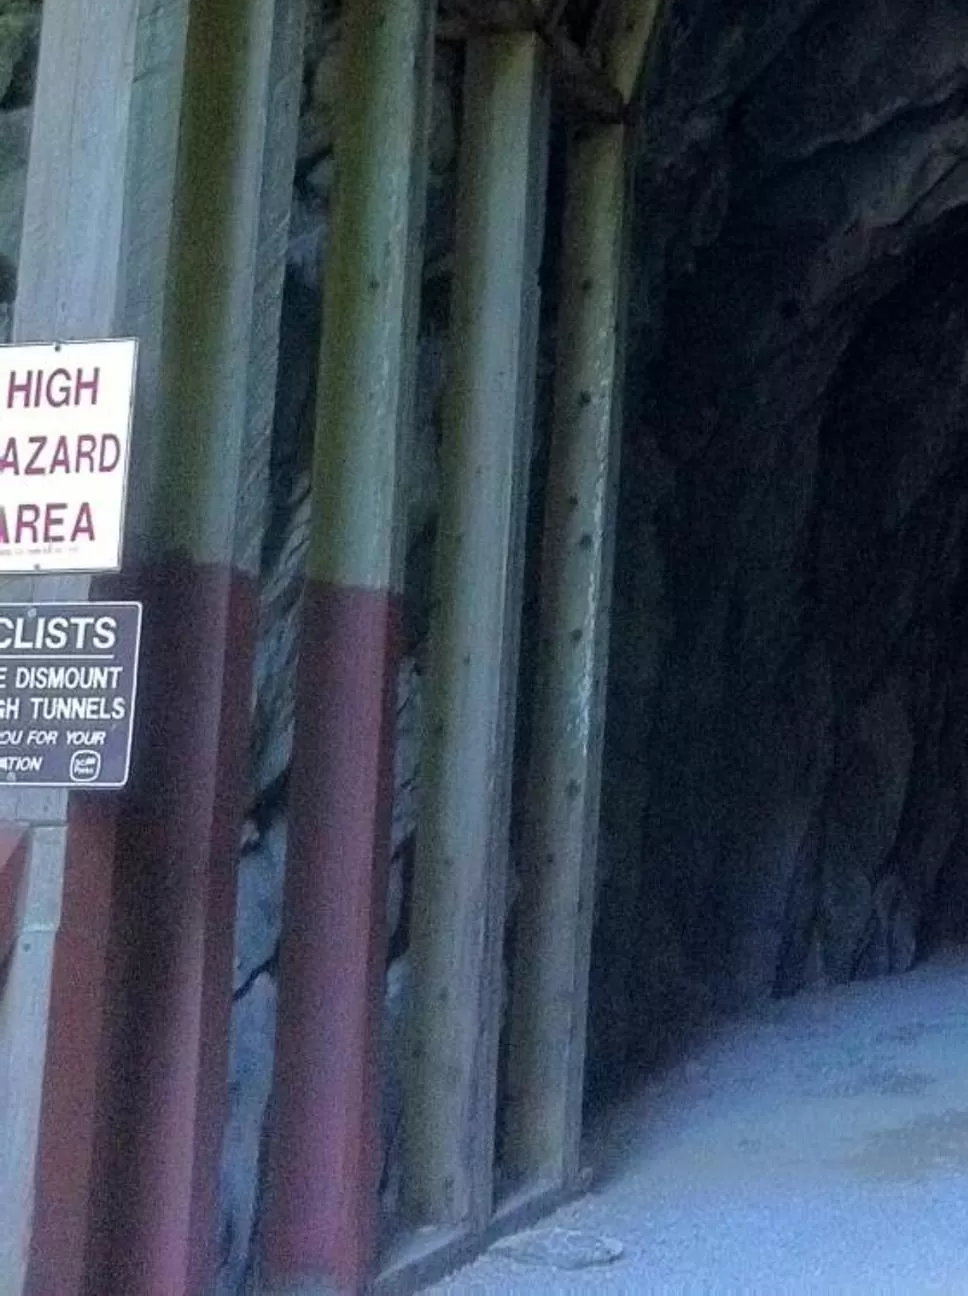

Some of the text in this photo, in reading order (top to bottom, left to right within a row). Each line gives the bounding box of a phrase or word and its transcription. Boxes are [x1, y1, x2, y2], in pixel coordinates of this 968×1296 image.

[7, 367, 100, 408] HIGH
[15, 666, 123, 689] DISMOUNT
[30, 697, 126, 720] TUNNELS
[27, 730, 59, 746] FOR
[66, 730, 107, 746] YOUR
